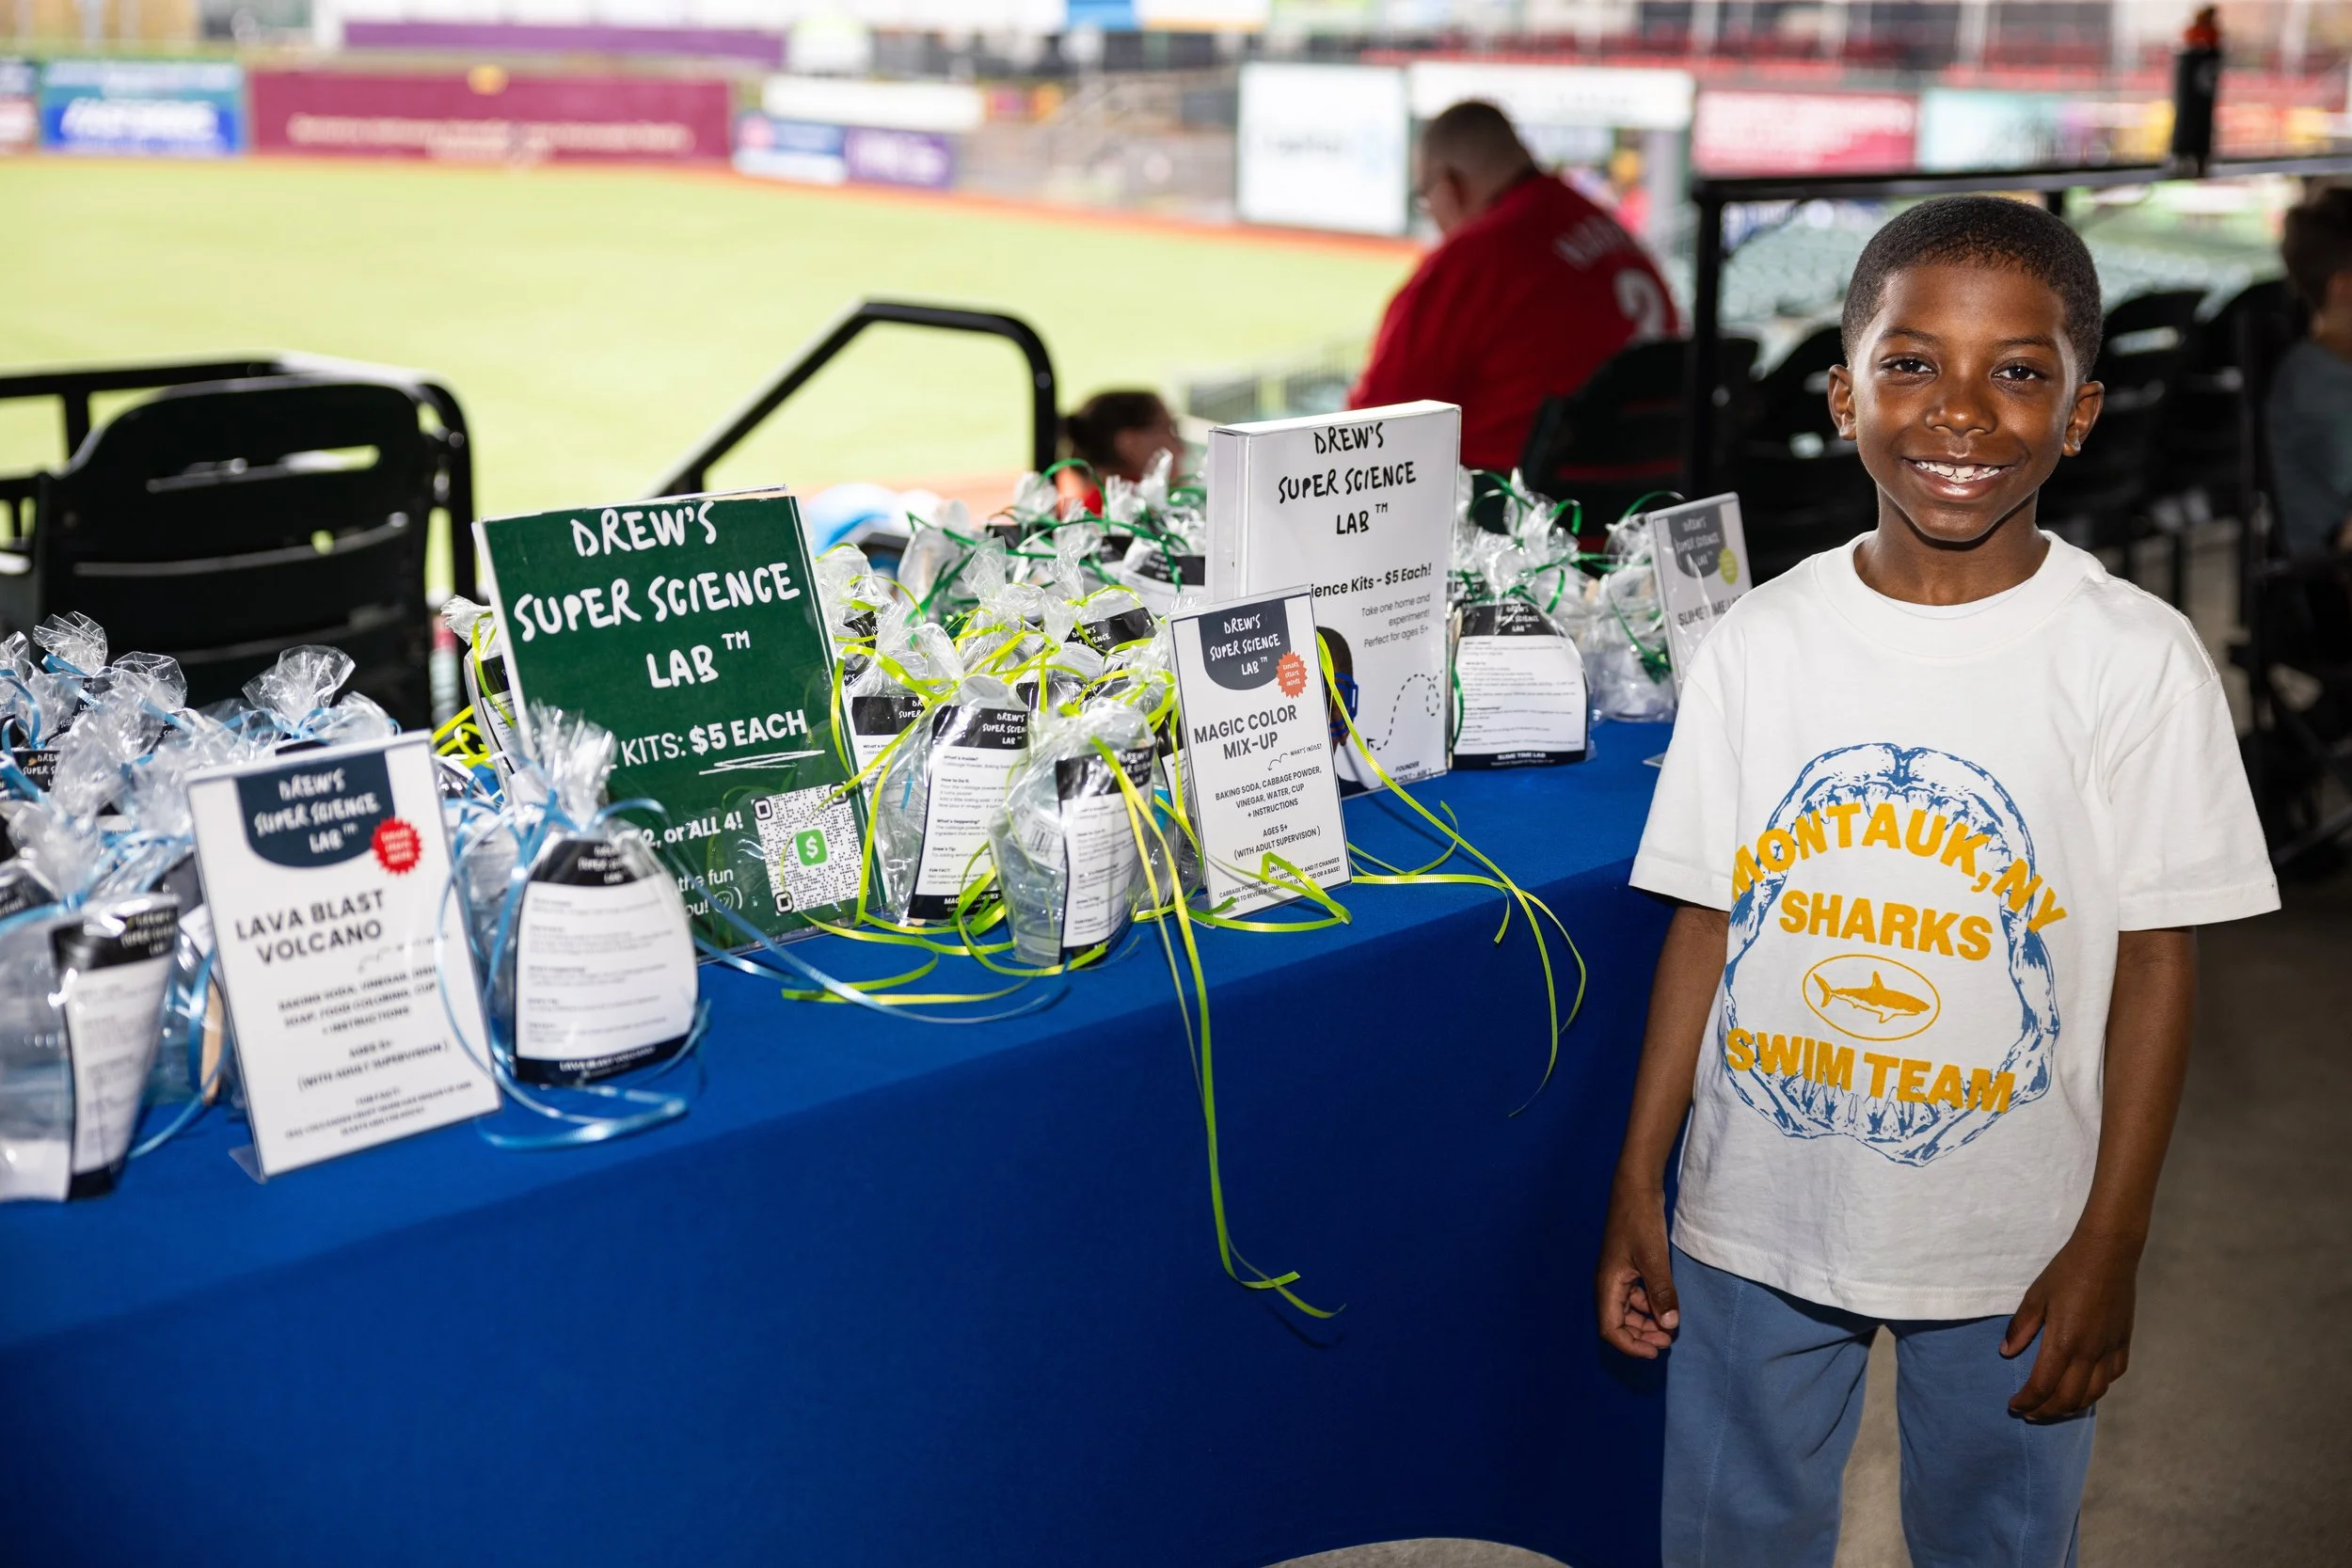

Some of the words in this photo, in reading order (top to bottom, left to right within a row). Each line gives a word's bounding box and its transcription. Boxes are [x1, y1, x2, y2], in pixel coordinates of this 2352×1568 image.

[1313, 420, 1385, 455] DREW'S
[1278, 468, 1339, 504] SUPER
[1344, 460, 1417, 496] SCIENCE
[570, 500, 717, 557] DREW'S
[1336, 510, 1370, 535] LAB
[1375, 502, 1389, 515] TM
[1311, 582, 1348, 599] ience
[1351, 576, 1375, 593] Kits
[1385, 570, 1399, 587] $5
[1401, 562, 1433, 582] Each!
[514, 578, 642, 641] SUPER
[647, 562, 801, 622] SCIENCE
[1361, 605, 1379, 617] Take
[1379, 603, 1393, 612] one
[1394, 597, 1415, 610] home
[1416, 593, 1431, 605] and
[1224, 613, 1261, 634] DREW'S
[1363, 633, 1390, 648] Perfect
[1391, 630, 1400, 642] for
[1401, 627, 1419, 641] ages
[1420, 625, 1429, 635] 5+
[646, 644, 719, 689] LAB
[721, 630, 751, 651] TM
[1210, 640, 1241, 661] SUPER
[1242, 633, 1280, 655] SCIENCE
[1241, 660, 1260, 675] LAB
[982, 723, 1005, 733] SUPER
[997, 712, 1025, 722] DREW'S
[1194, 717, 1245, 744] MAGIC
[1248, 705, 1297, 730] COLOR
[621, 732, 687, 767] KITS:
[689, 722, 727, 756] $5
[730, 709, 808, 747] EACH
[1002, 736, 1016, 745] LAB
[1223, 731, 1279, 760] MIX-UP
[278, 768, 346, 800] DREW'S
[1216, 786, 1241, 801] BAKING
[1242, 782, 1262, 794] SODA,
[1262, 772, 1293, 788] CABBAGE
[1293, 766, 1323, 781] POWDER,
[1235, 794, 1266, 809] VINEGAR,
[1266, 786, 1291, 800] WATER,
[1291, 783, 1305, 794] CUP
[254, 803, 310, 837] SUPER
[310, 792, 381, 826] SCIENCE
[1252, 798, 1298, 818] INSTRUCTIONS
[309, 829, 344, 854] LAB
[664, 826, 686, 844] or
[689, 816, 721, 839] ALL
[724, 811, 744, 831] 4!
[1234, 845, 1255, 861] (WITH
[1255, 840, 1276, 854] ADULT
[1276, 827, 1316, 847] SUPERVISION
[1263, 825, 1279, 838] AGES
[1279, 824, 1288, 833] 5+
[707, 868, 734, 884] fun
[1219, 886, 1241, 899] CABBAGE
[1279, 870, 1295, 880] SECRE
[1319, 856, 1341, 869] CHANGES
[1268, 865, 1278, 874] UN
[1732, 802, 1993, 901] MONTAUK,
[1991, 858, 2068, 935] NY
[235, 908, 303, 941] LAVA
[310, 889, 384, 923] BLAST
[685, 899, 709, 918] ou!
[1779, 889, 1994, 961] SHARKS
[257, 920, 382, 965] VOLCANO
[1725, 1027, 1856, 1091] SWIM
[1863, 1053, 2017, 1114] TEAM
